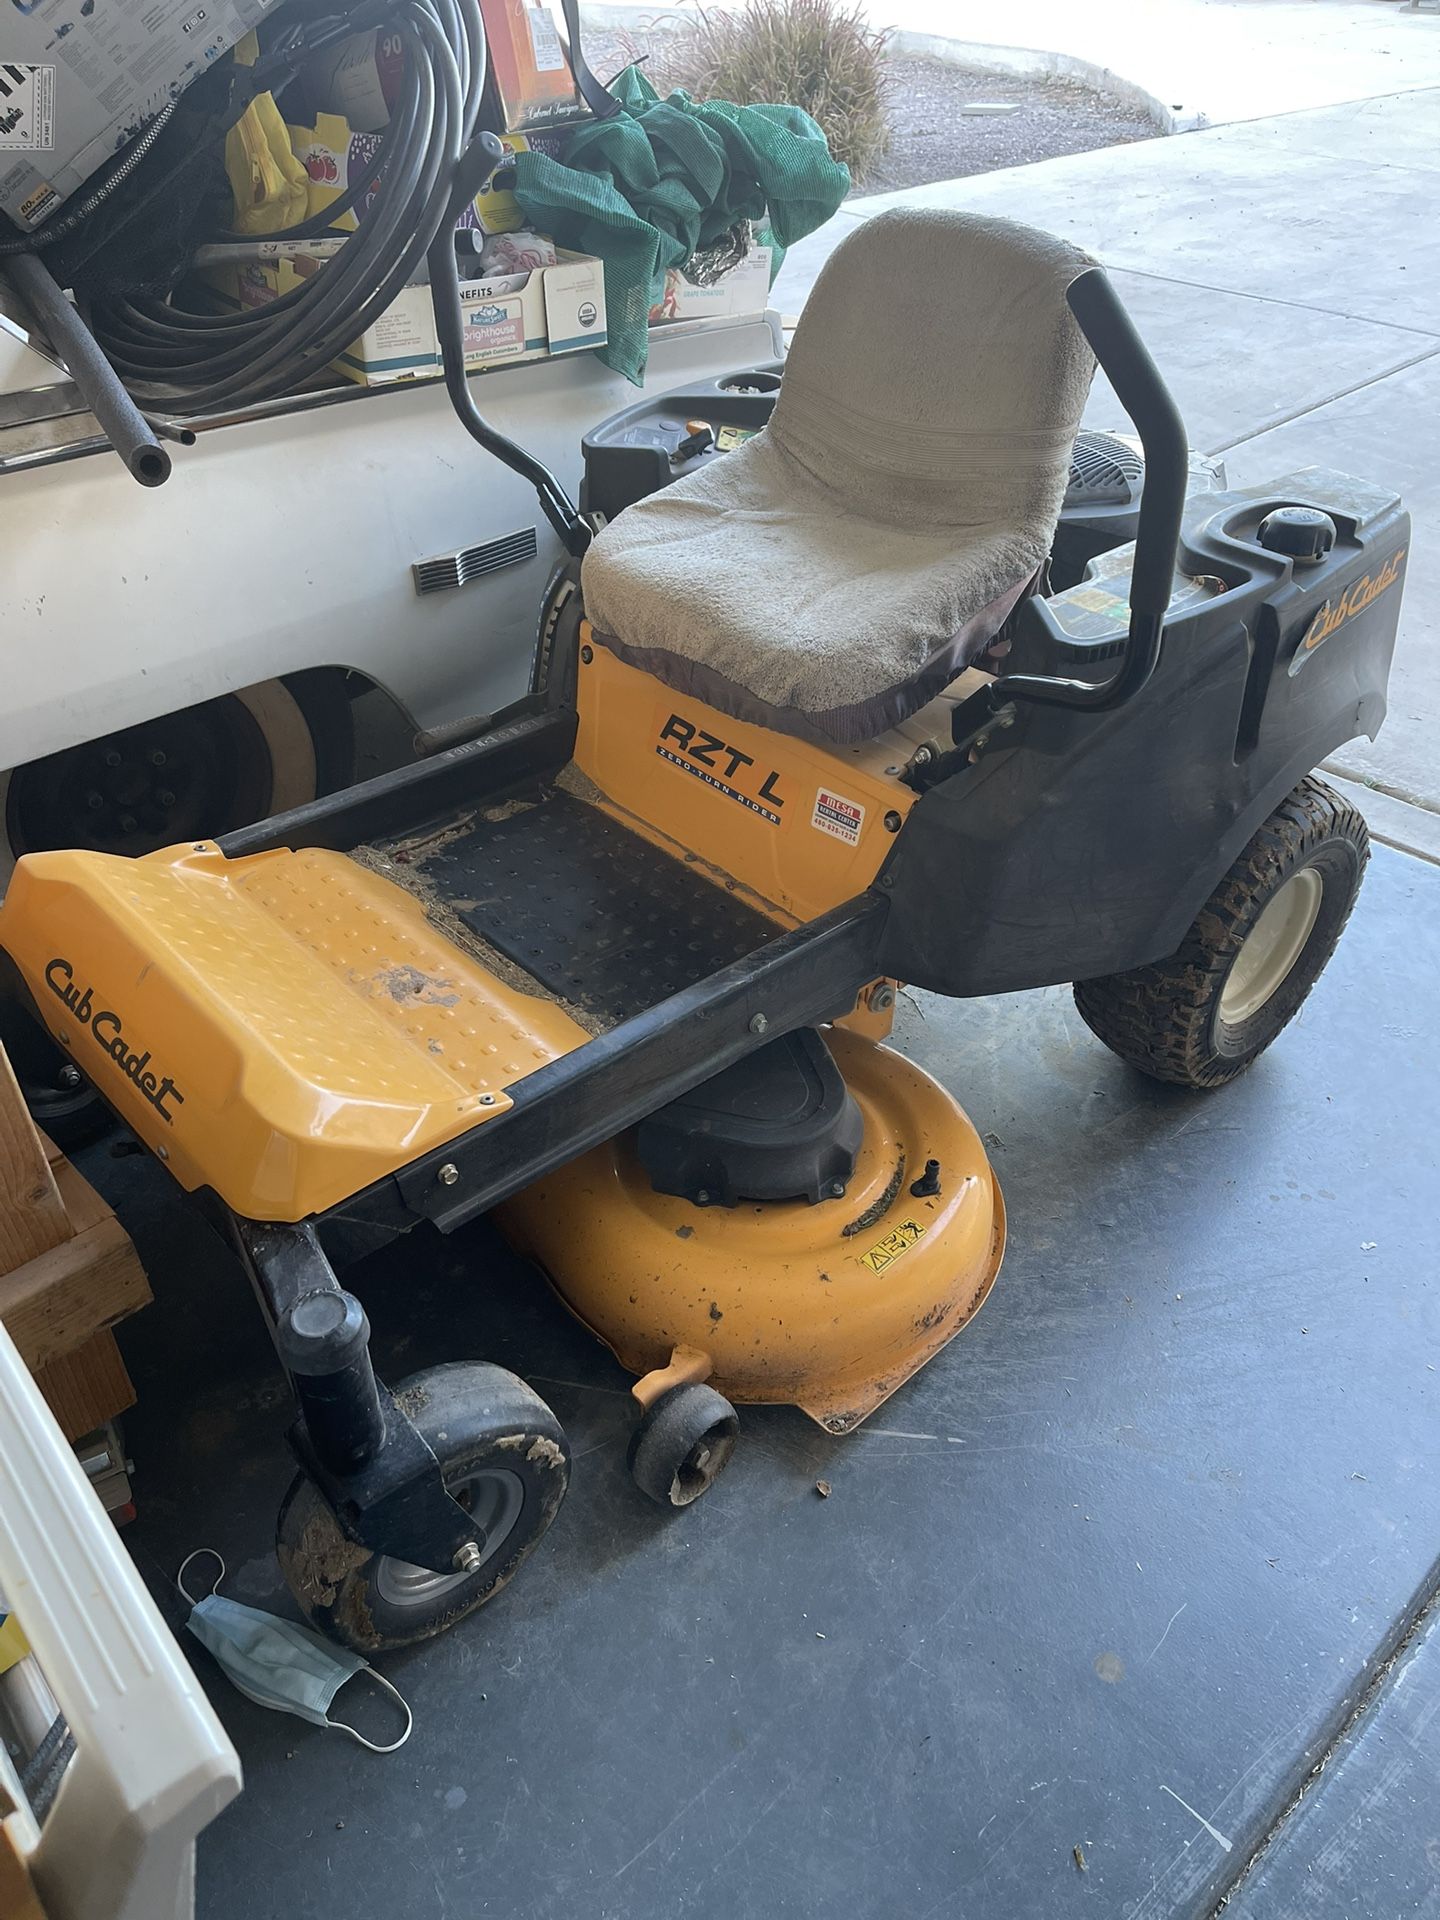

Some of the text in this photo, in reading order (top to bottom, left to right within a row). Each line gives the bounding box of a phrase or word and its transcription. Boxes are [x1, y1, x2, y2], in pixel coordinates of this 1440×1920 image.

[383, 34, 402, 58] 90
[1305, 549, 1407, 650] Cub Cadet
[659, 713, 785, 808] RZT L
[737, 794, 778, 823] RIDER
[819, 806, 838, 820] RENTAL
[837, 813, 858, 828] CENTER
[826, 797, 855, 816] MESA
[44, 957, 185, 1123] Cub Cadet
